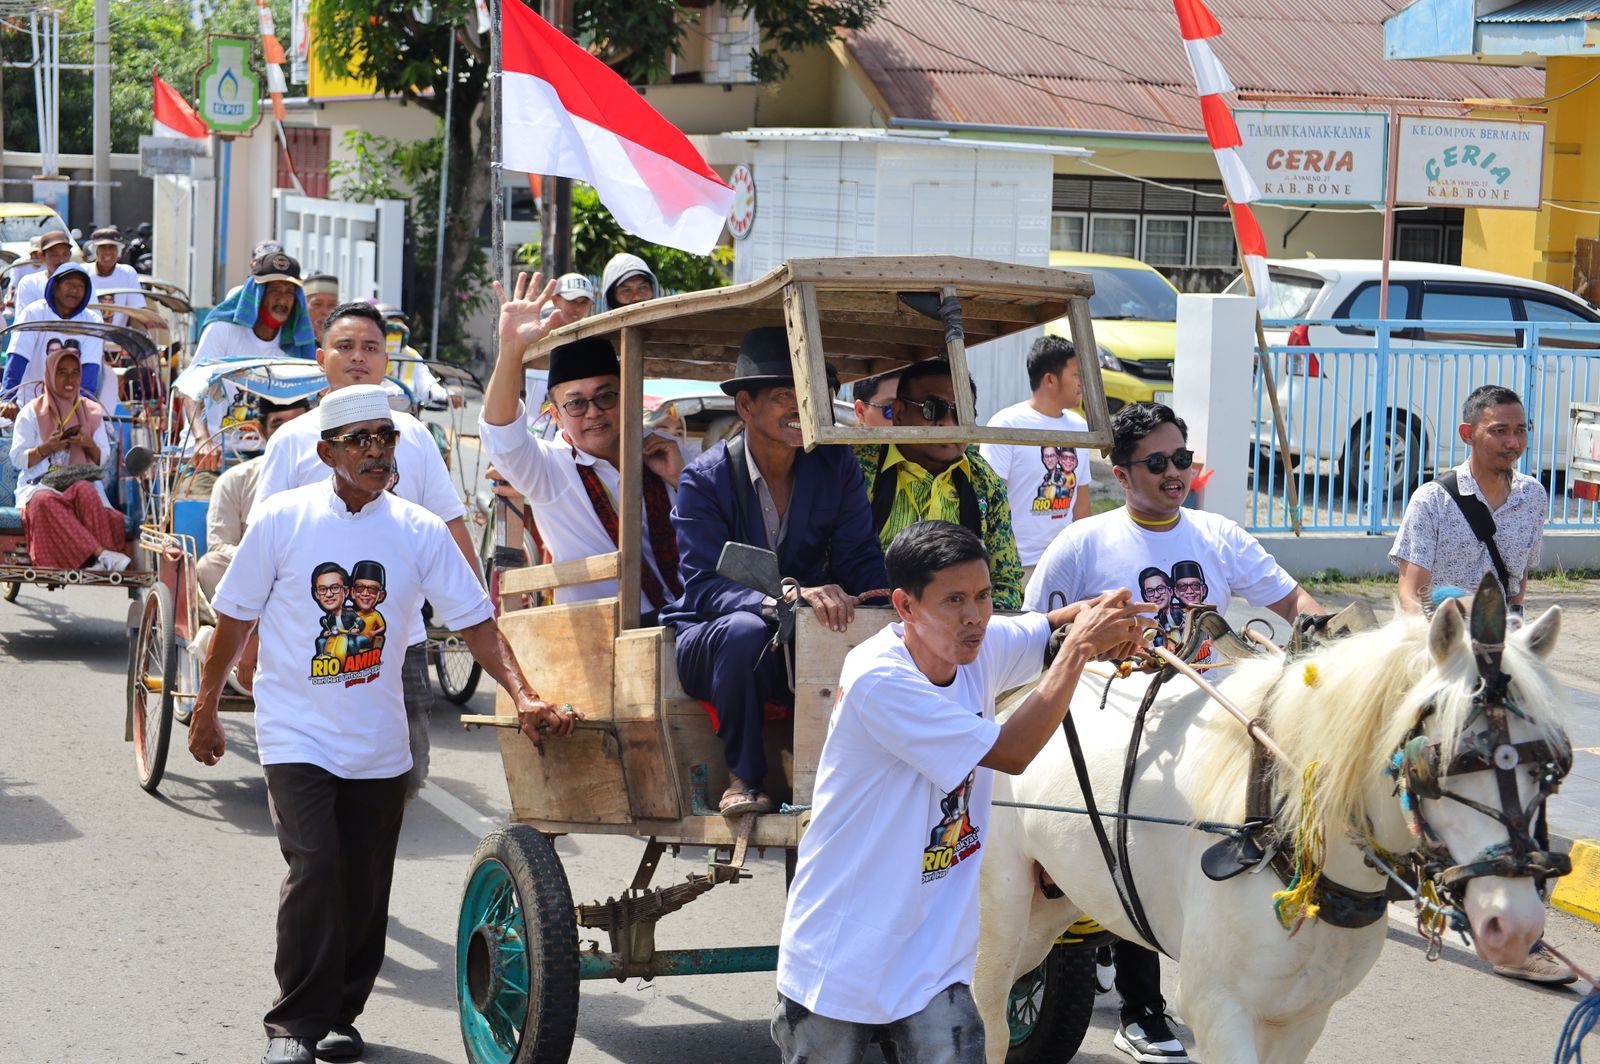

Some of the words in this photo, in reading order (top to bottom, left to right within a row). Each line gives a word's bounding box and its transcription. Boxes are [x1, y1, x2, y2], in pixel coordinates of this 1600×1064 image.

[1248, 124, 1289, 137] TAMAN
[1292, 125, 1371, 139] KANAK-KANAK
[1412, 125, 1476, 138] KELOMPOK
[1480, 128, 1530, 141] BERMAIN
[1266, 148, 1354, 173] CERIA
[1425, 145, 1511, 185] CERIA
[1307, 183, 1352, 195] BONE
[1467, 188, 1510, 200] BONE
[1033, 499, 1051, 511] RIO
[312, 658, 340, 676] RIO
[344, 649, 381, 672] AMIR
[923, 846, 954, 872] RIO
